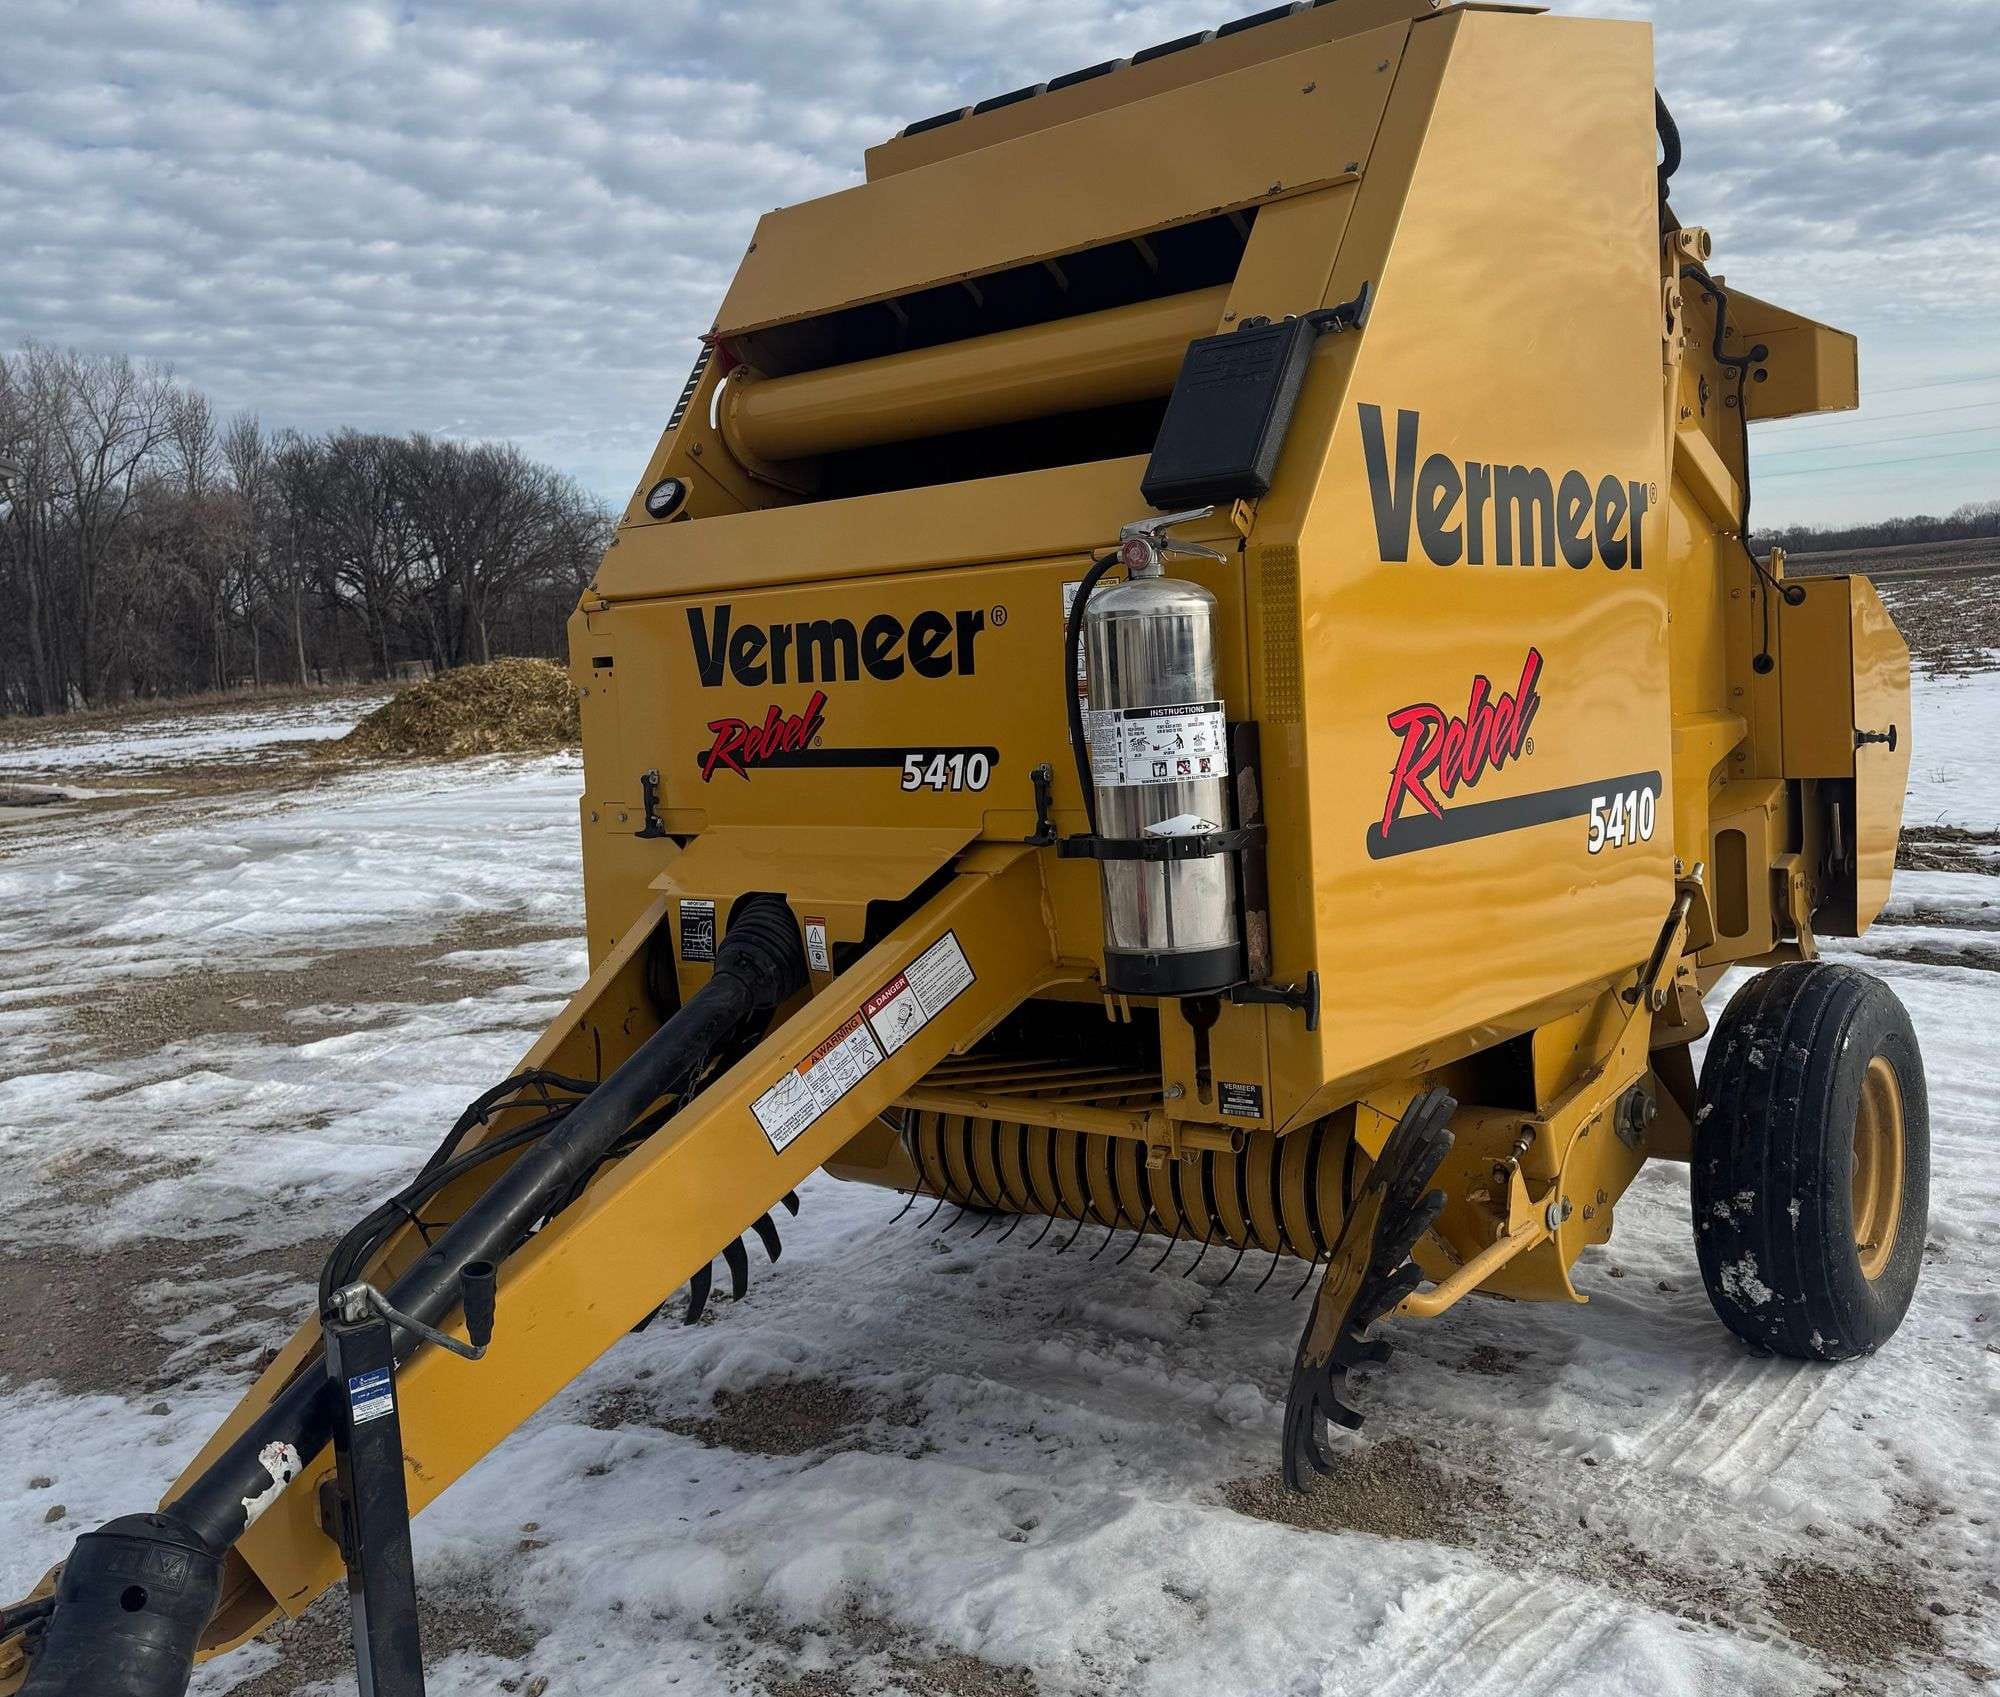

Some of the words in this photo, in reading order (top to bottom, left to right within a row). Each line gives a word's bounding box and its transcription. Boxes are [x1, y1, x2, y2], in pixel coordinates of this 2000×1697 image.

[1357, 401, 1650, 571] Vermeer
[686, 604, 986, 688] Vermeer
[701, 690, 829, 784] Rebel
[1150, 705, 1205, 717] INSTRUCTIONS
[1381, 646, 1544, 839] Rebel
[900, 752, 992, 793] 5410
[1113, 711, 1126, 784] WATER
[1587, 786, 1657, 855] 5410
[874, 977, 906, 1008] DANGER
[817, 1018, 860, 1057] WARNING
[1223, 1083, 1256, 1092] VERMEER
